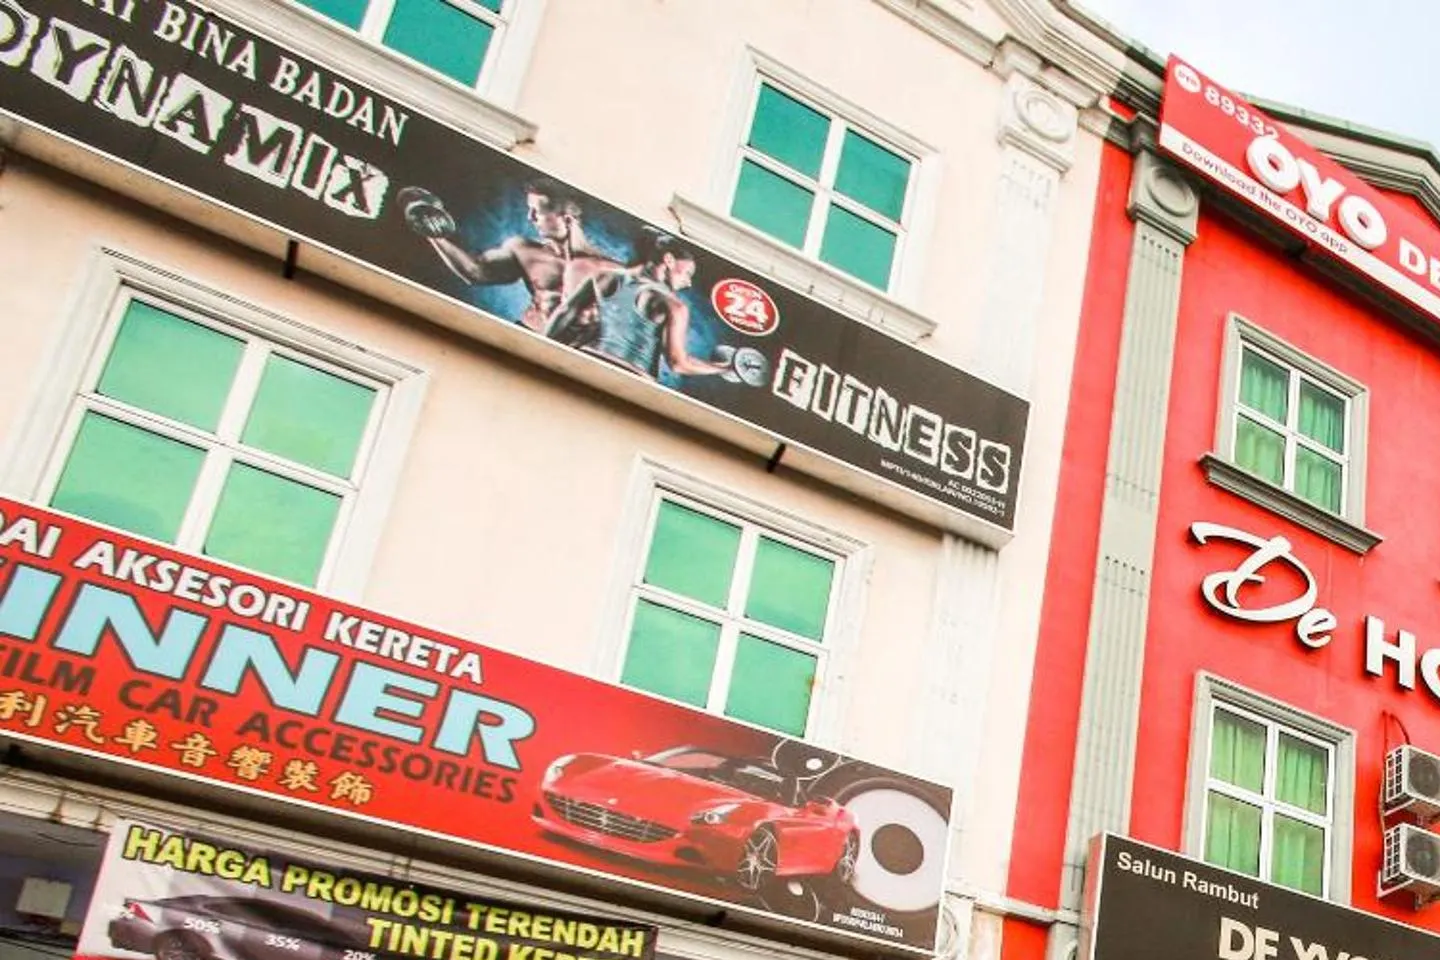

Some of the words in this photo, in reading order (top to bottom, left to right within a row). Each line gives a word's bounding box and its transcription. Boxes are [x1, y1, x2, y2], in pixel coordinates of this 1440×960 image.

[154, 2, 257, 80] BINA
[270, 60, 410, 148] BADAN
[1180, 142, 1258, 198] Download
[1259, 187, 1283, 213] the
[1285, 204, 1319, 235] OYO
[1320, 229, 1350, 255] app
[1246, 134, 1388, 250] OYO
[723, 290, 768, 323] 24
[773, 348, 1010, 494] FITNESS
[0, 510, 63, 560] AI
[73, 540, 310, 632] AKSESORI
[324, 609, 484, 686] KERETA
[1190, 521, 1338, 648] De
[0, 556, 537, 771] INNER
[0, 642, 97, 697] ILM
[117, 679, 220, 730] CAR
[235, 711, 521, 805] ACCESSORIES
[122, 825, 273, 888] HARGA
[281, 863, 454, 925] PROMOSI
[465, 902, 645, 958] TERENDAH
[264, 933, 301, 951] 35%
[1117, 851, 1177, 886] Salun
[1182, 870, 1260, 910] Rambut
